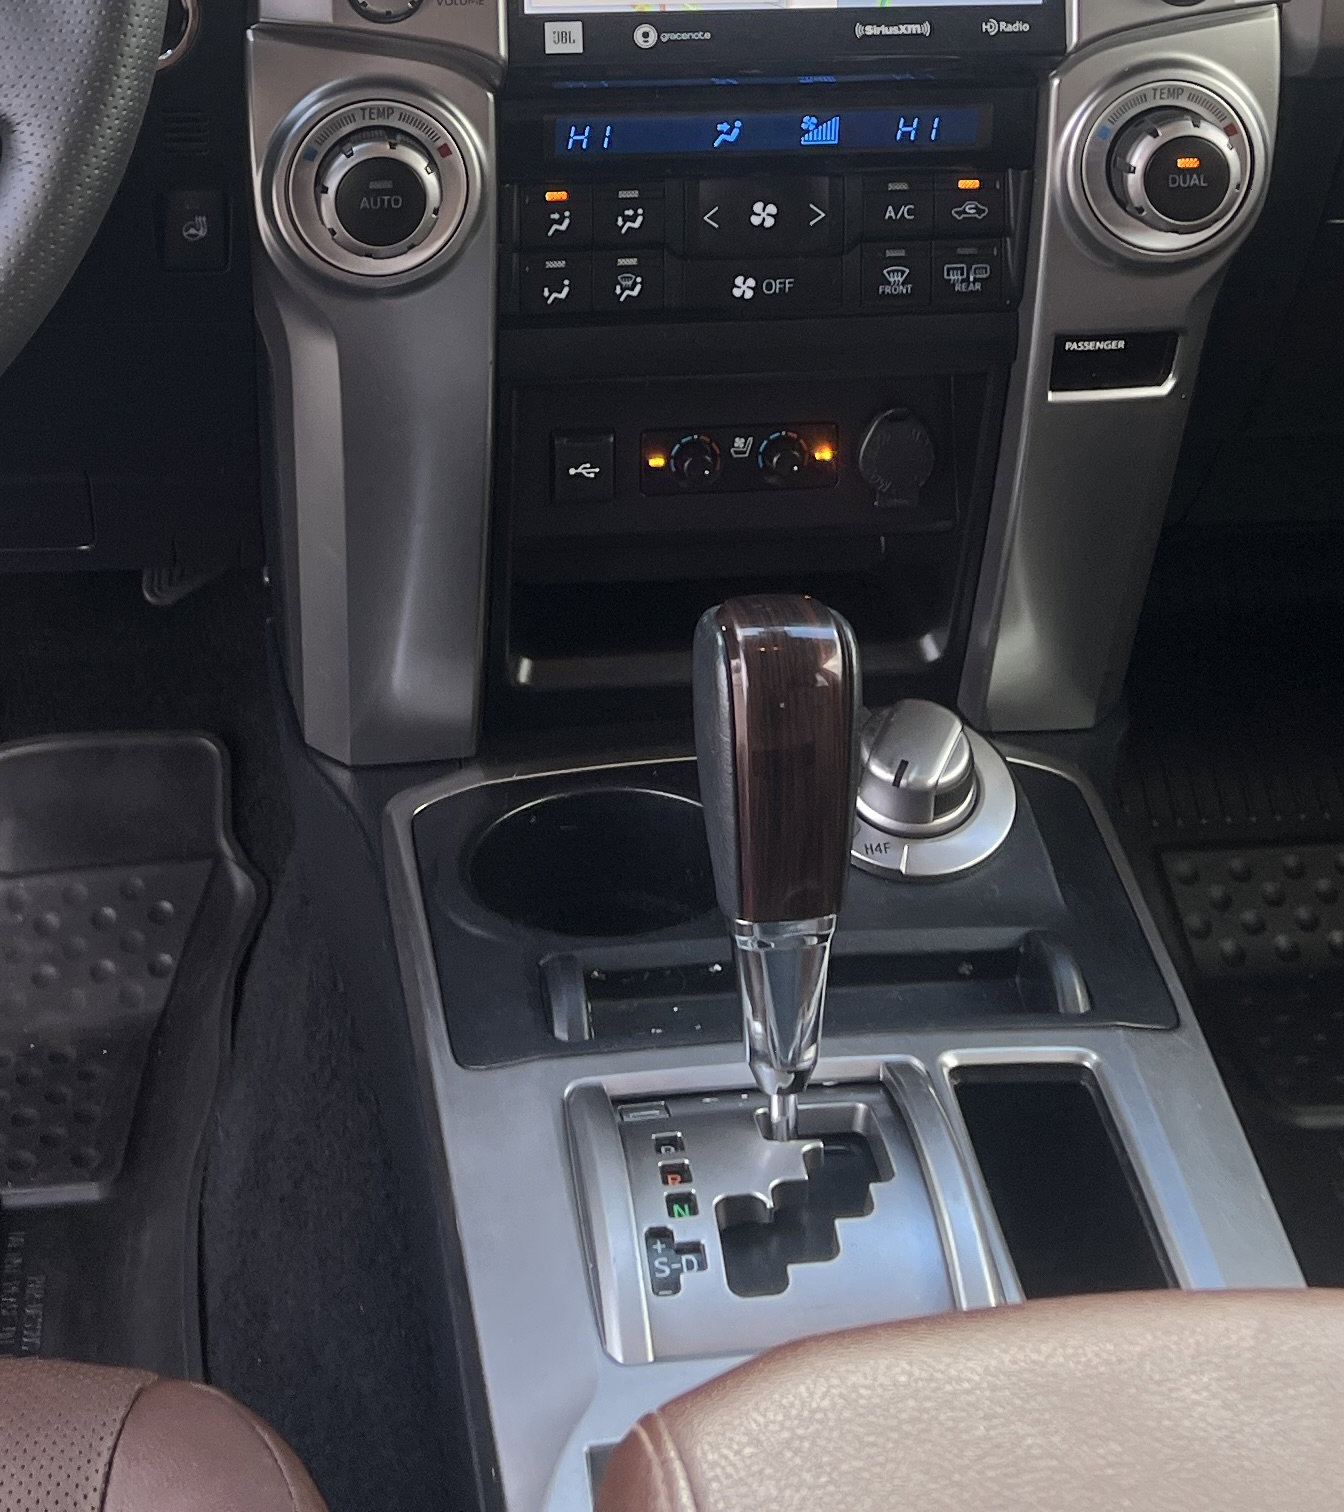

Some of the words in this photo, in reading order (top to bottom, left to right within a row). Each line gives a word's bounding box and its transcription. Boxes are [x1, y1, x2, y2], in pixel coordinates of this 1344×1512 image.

[981, 19, 999, 36] HD
[999, 20, 1030, 32] Radio
[552, 30, 576, 45] JBL
[660, 31, 712, 43] gracenote
[1151, 87, 1185, 101] TEMP
[359, 106, 395, 121] TEMP
[1168, 173, 1208, 187] DUAL
[359, 195, 403, 210] AUTO
[884, 204, 915, 221] A/C
[762, 277, 795, 295] OFF
[878, 282, 913, 295] FRONT
[955, 280, 982, 292] REAR
[1065, 338, 1126, 352] PASSENGER
[864, 841, 892, 856] H4F
[672, 1203, 690, 1219] N
